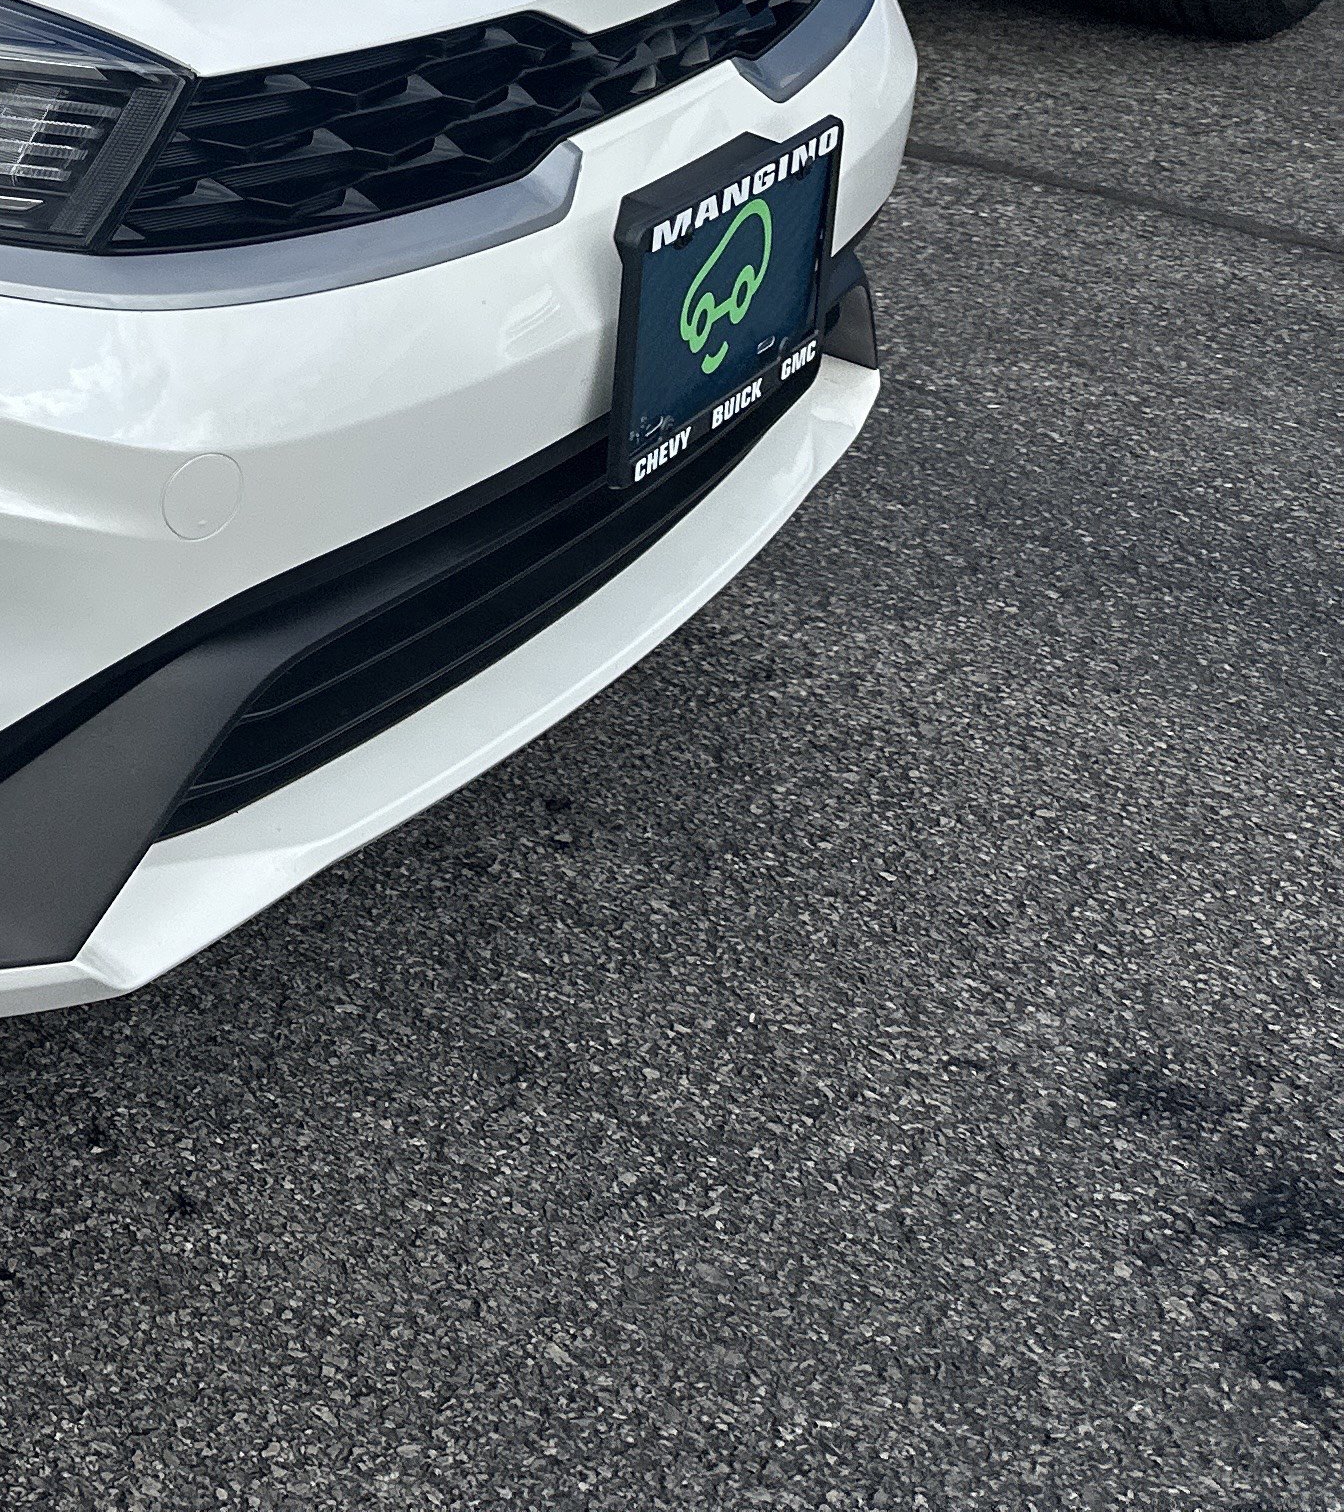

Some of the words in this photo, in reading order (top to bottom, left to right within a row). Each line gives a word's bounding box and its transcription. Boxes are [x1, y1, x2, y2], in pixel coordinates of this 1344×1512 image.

[651, 125, 840, 253] MANGINO
[634, 426, 693, 483] CHEVY
[711, 377, 764, 430] BUICK
[780, 339, 818, 381] GMC
